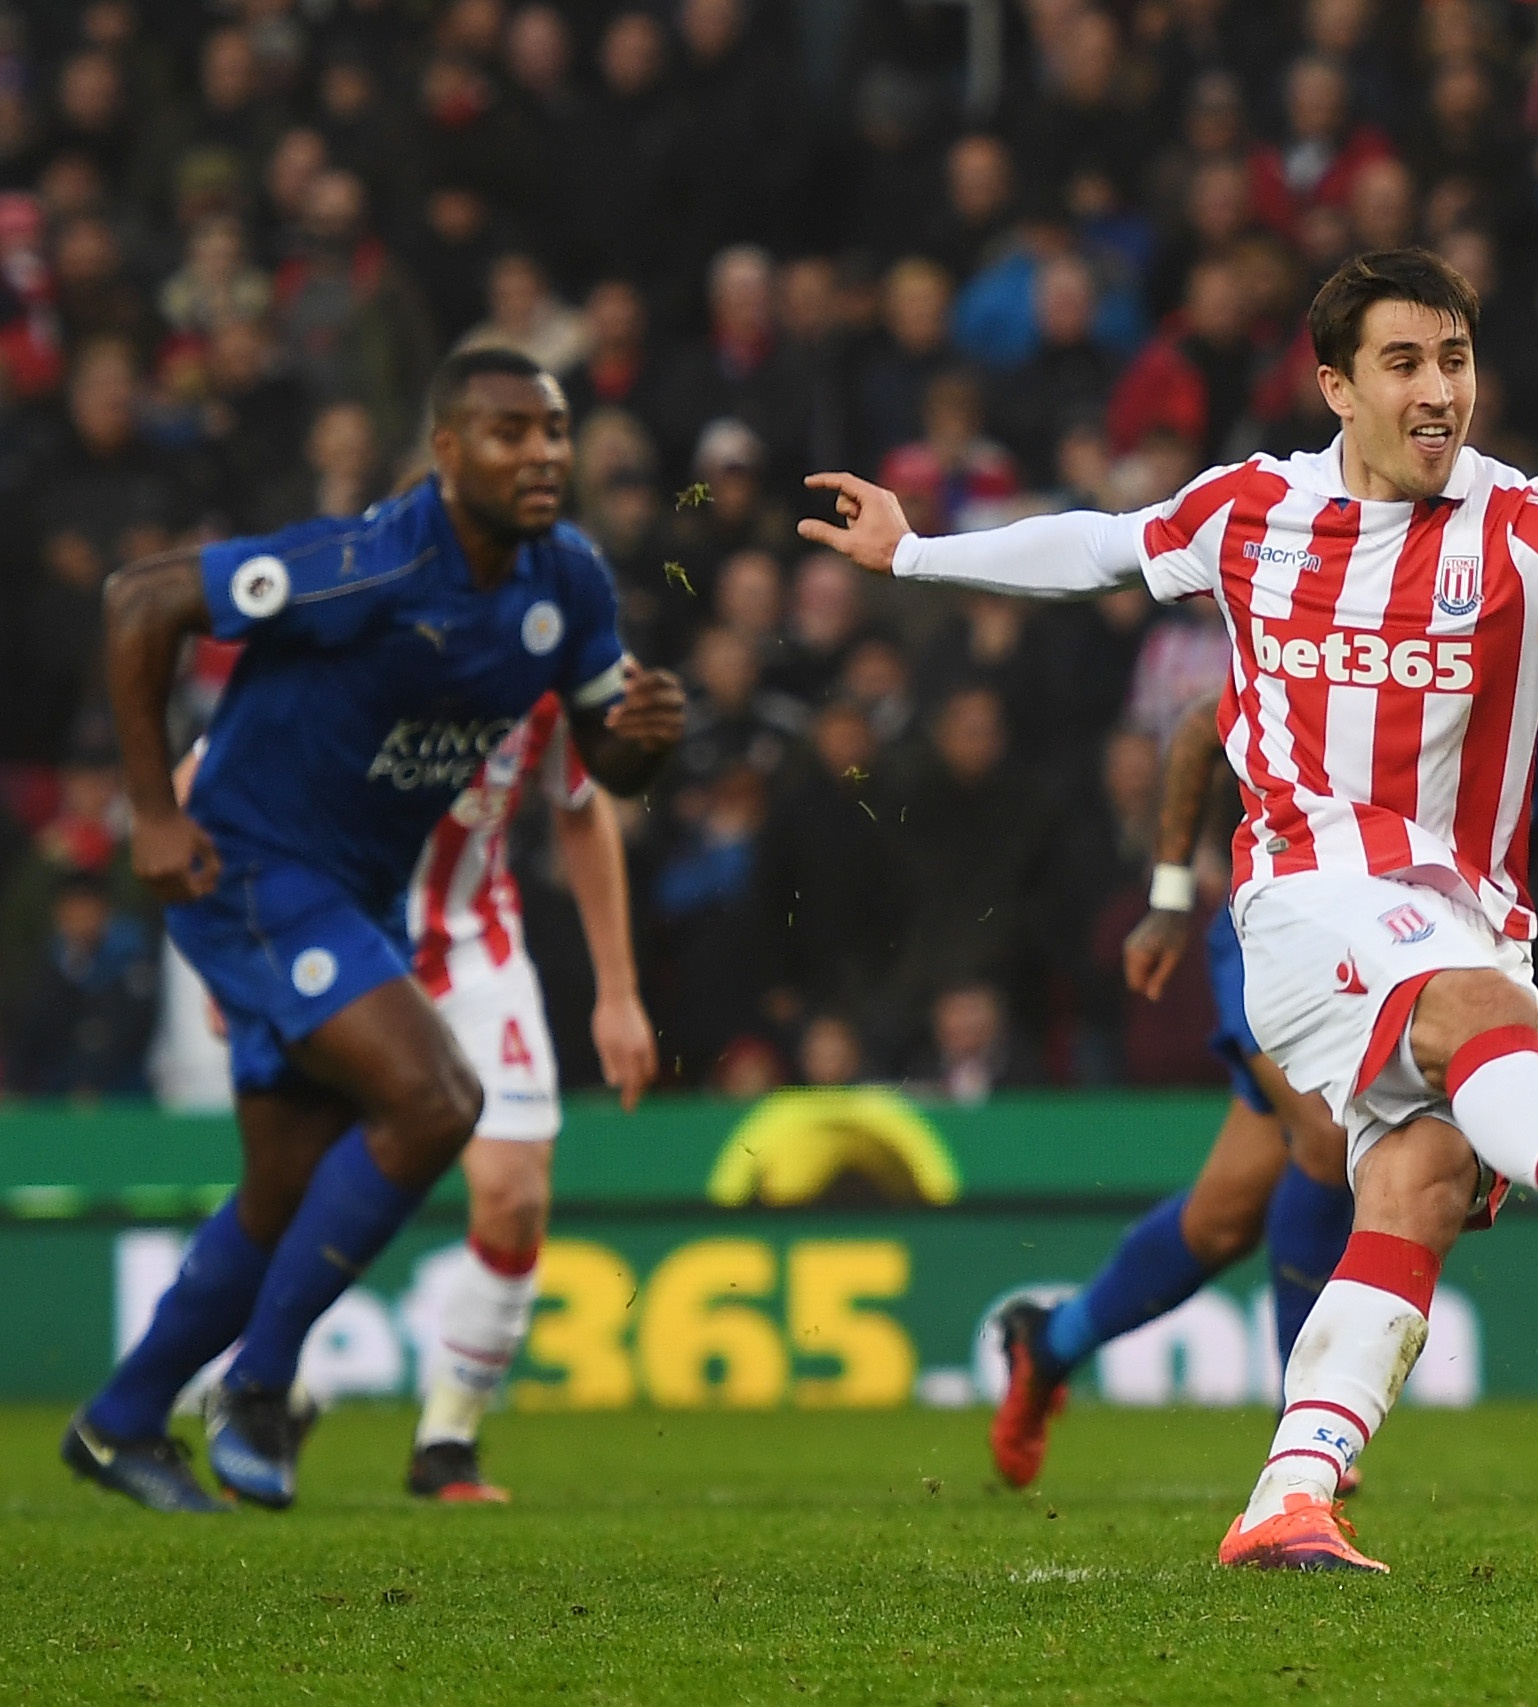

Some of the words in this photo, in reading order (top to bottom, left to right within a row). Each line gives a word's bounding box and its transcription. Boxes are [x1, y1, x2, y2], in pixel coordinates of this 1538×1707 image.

[1244, 543, 1320, 570] macron
[1251, 617, 1474, 691] bet365
[502, 1016, 535, 1078] 4
